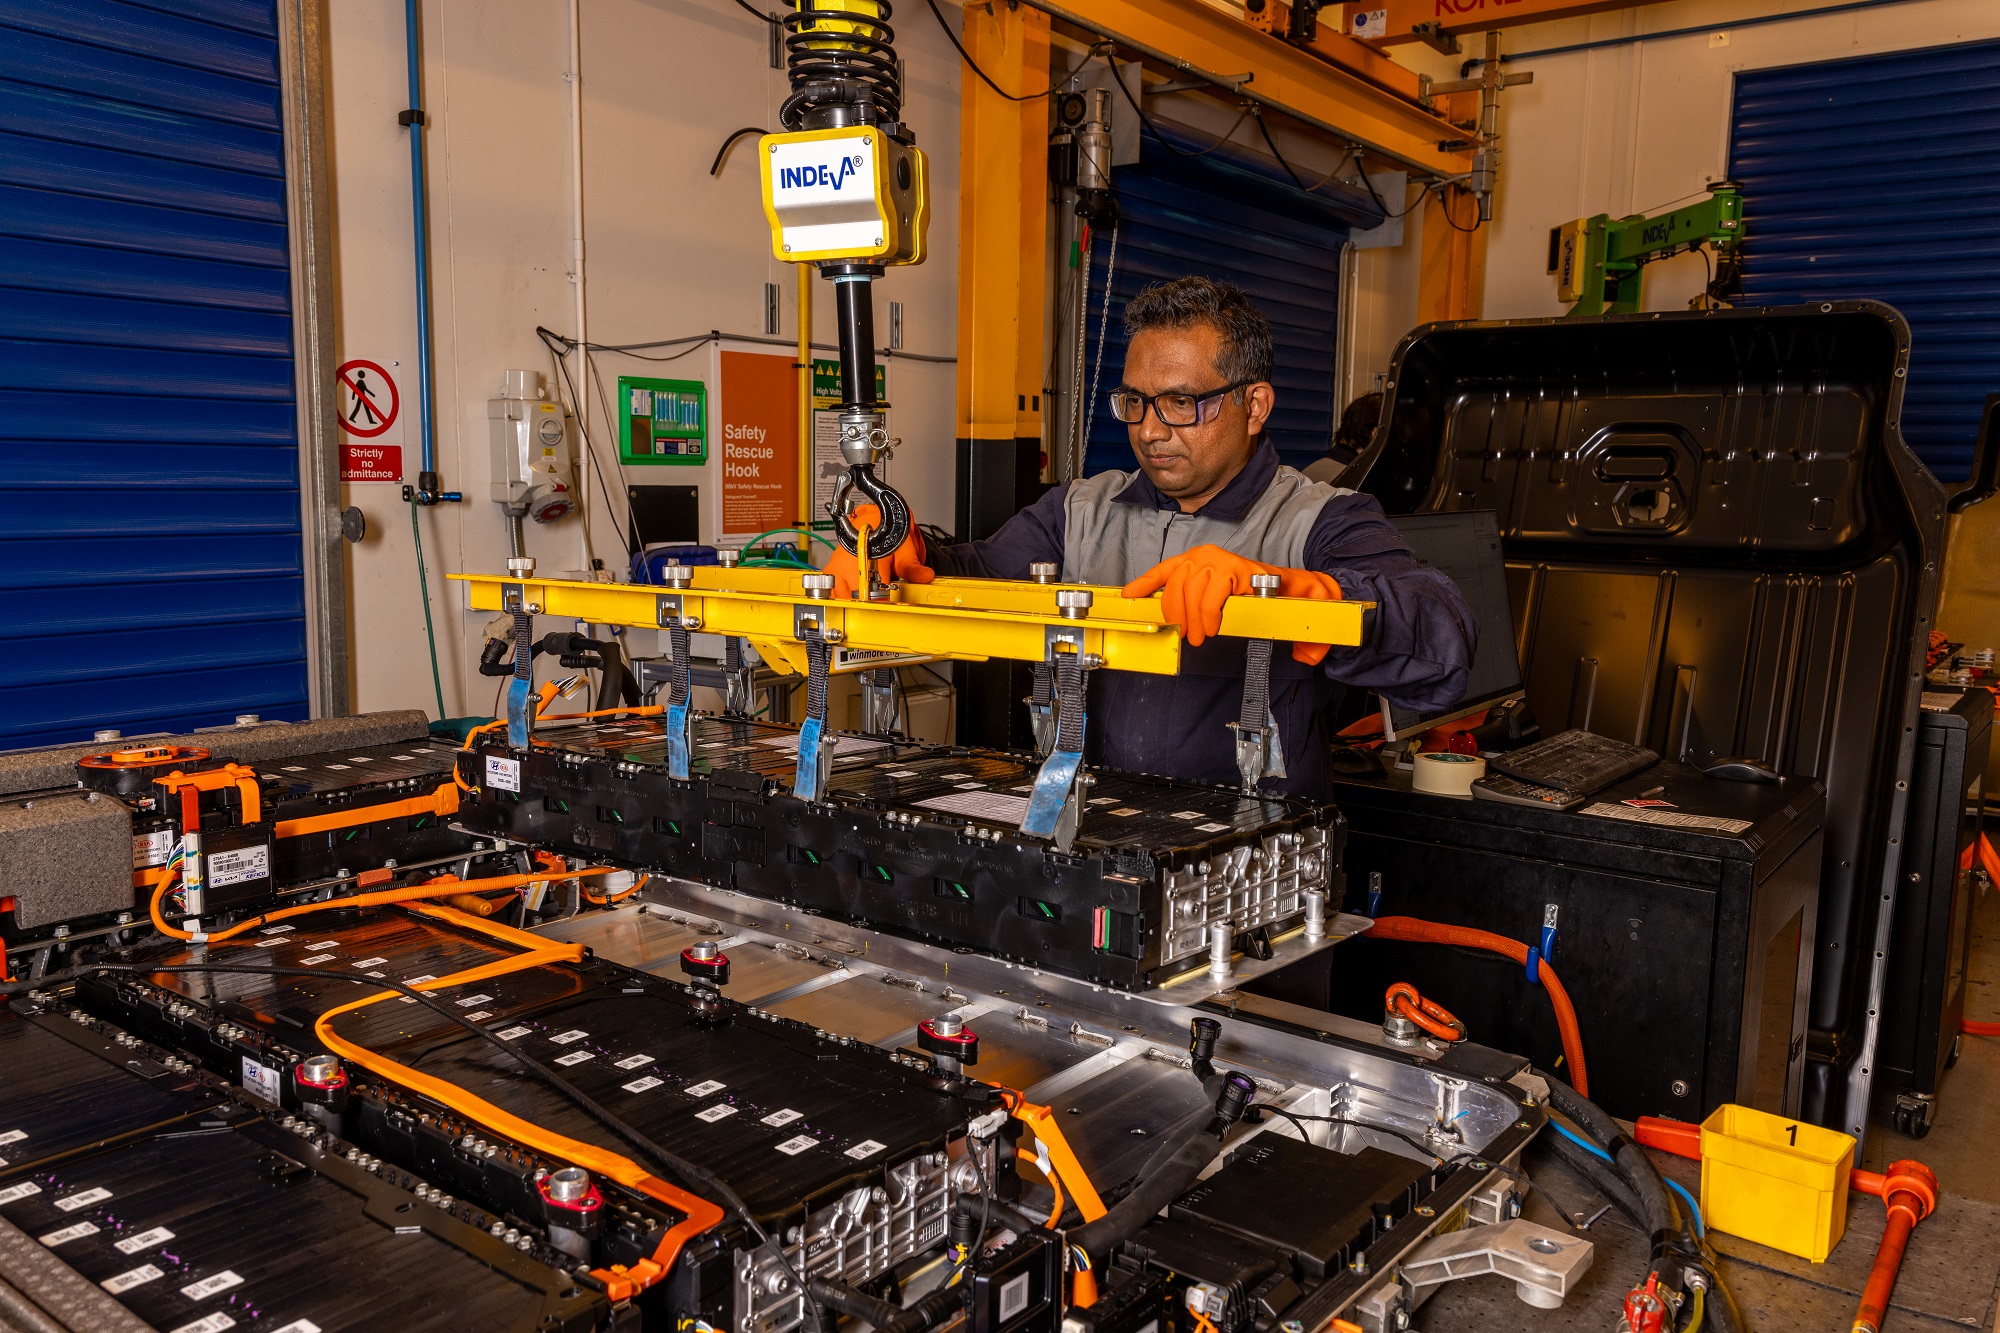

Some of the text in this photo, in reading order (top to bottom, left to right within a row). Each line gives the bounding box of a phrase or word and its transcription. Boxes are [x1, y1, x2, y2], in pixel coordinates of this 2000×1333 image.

[1642, 215, 1675, 245] INDEVA
[816, 387, 842, 396] High Volta
[724, 424, 767, 444] Safety
[350, 448, 384, 460] Strictly
[725, 443, 774, 459] Rescue
[361, 460, 374, 468] no
[725, 462, 760, 478] Hook
[341, 469, 393, 478] admittance
[738, 483, 752, 491] Safety
[1786, 1124, 1798, 1147] 1
